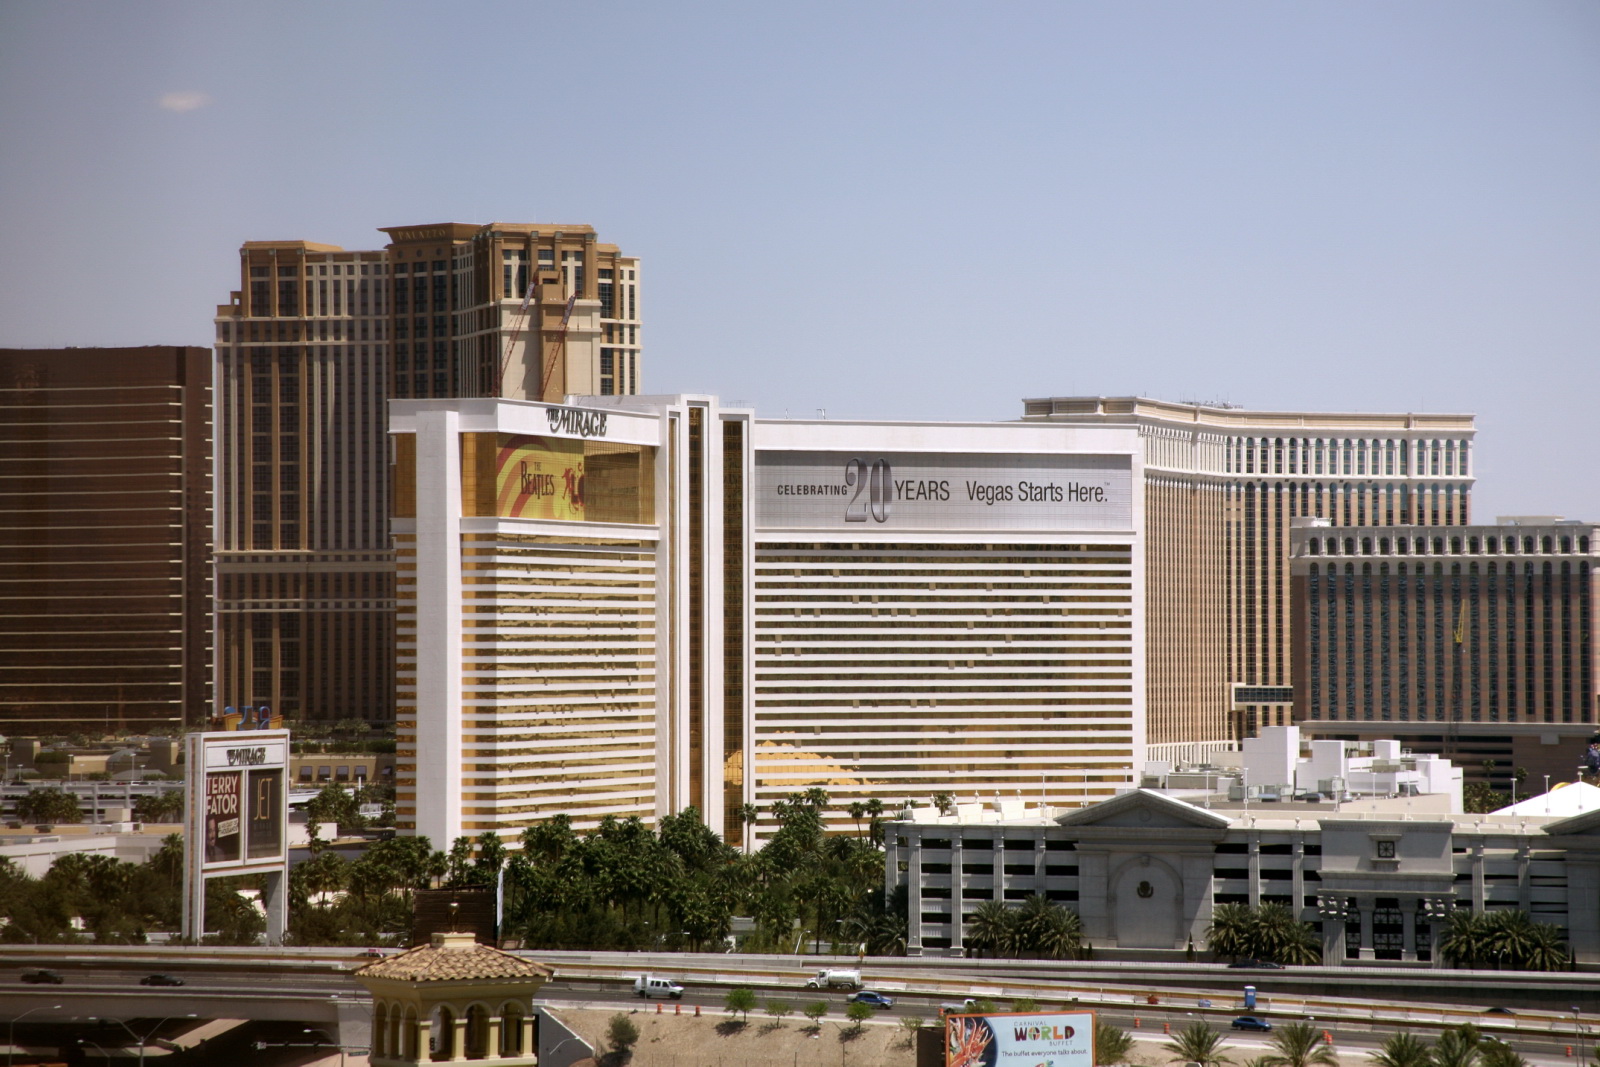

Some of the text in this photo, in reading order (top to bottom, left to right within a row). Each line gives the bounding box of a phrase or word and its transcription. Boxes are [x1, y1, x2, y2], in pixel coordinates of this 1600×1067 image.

[546, 408, 607, 438] THE MIRAGE
[520, 461, 555, 499] BEATLES
[777, 485, 848, 496] CELEBRATING
[845, 457, 893, 524] 20
[895, 480, 950, 501] YEARS
[966, 481, 1014, 506] Vegas
[1018, 481, 1064, 502] Starts
[229, 747, 266, 766] MIRAGE
[206, 775, 238, 795] TERRY
[206, 794, 238, 815] FATOR
[254, 778, 273, 820] JET
[1014, 1026, 1075, 1041] WORLD
[1031, 1049, 1057, 1057] everyone
[1058, 1048, 1070, 1056] talks
